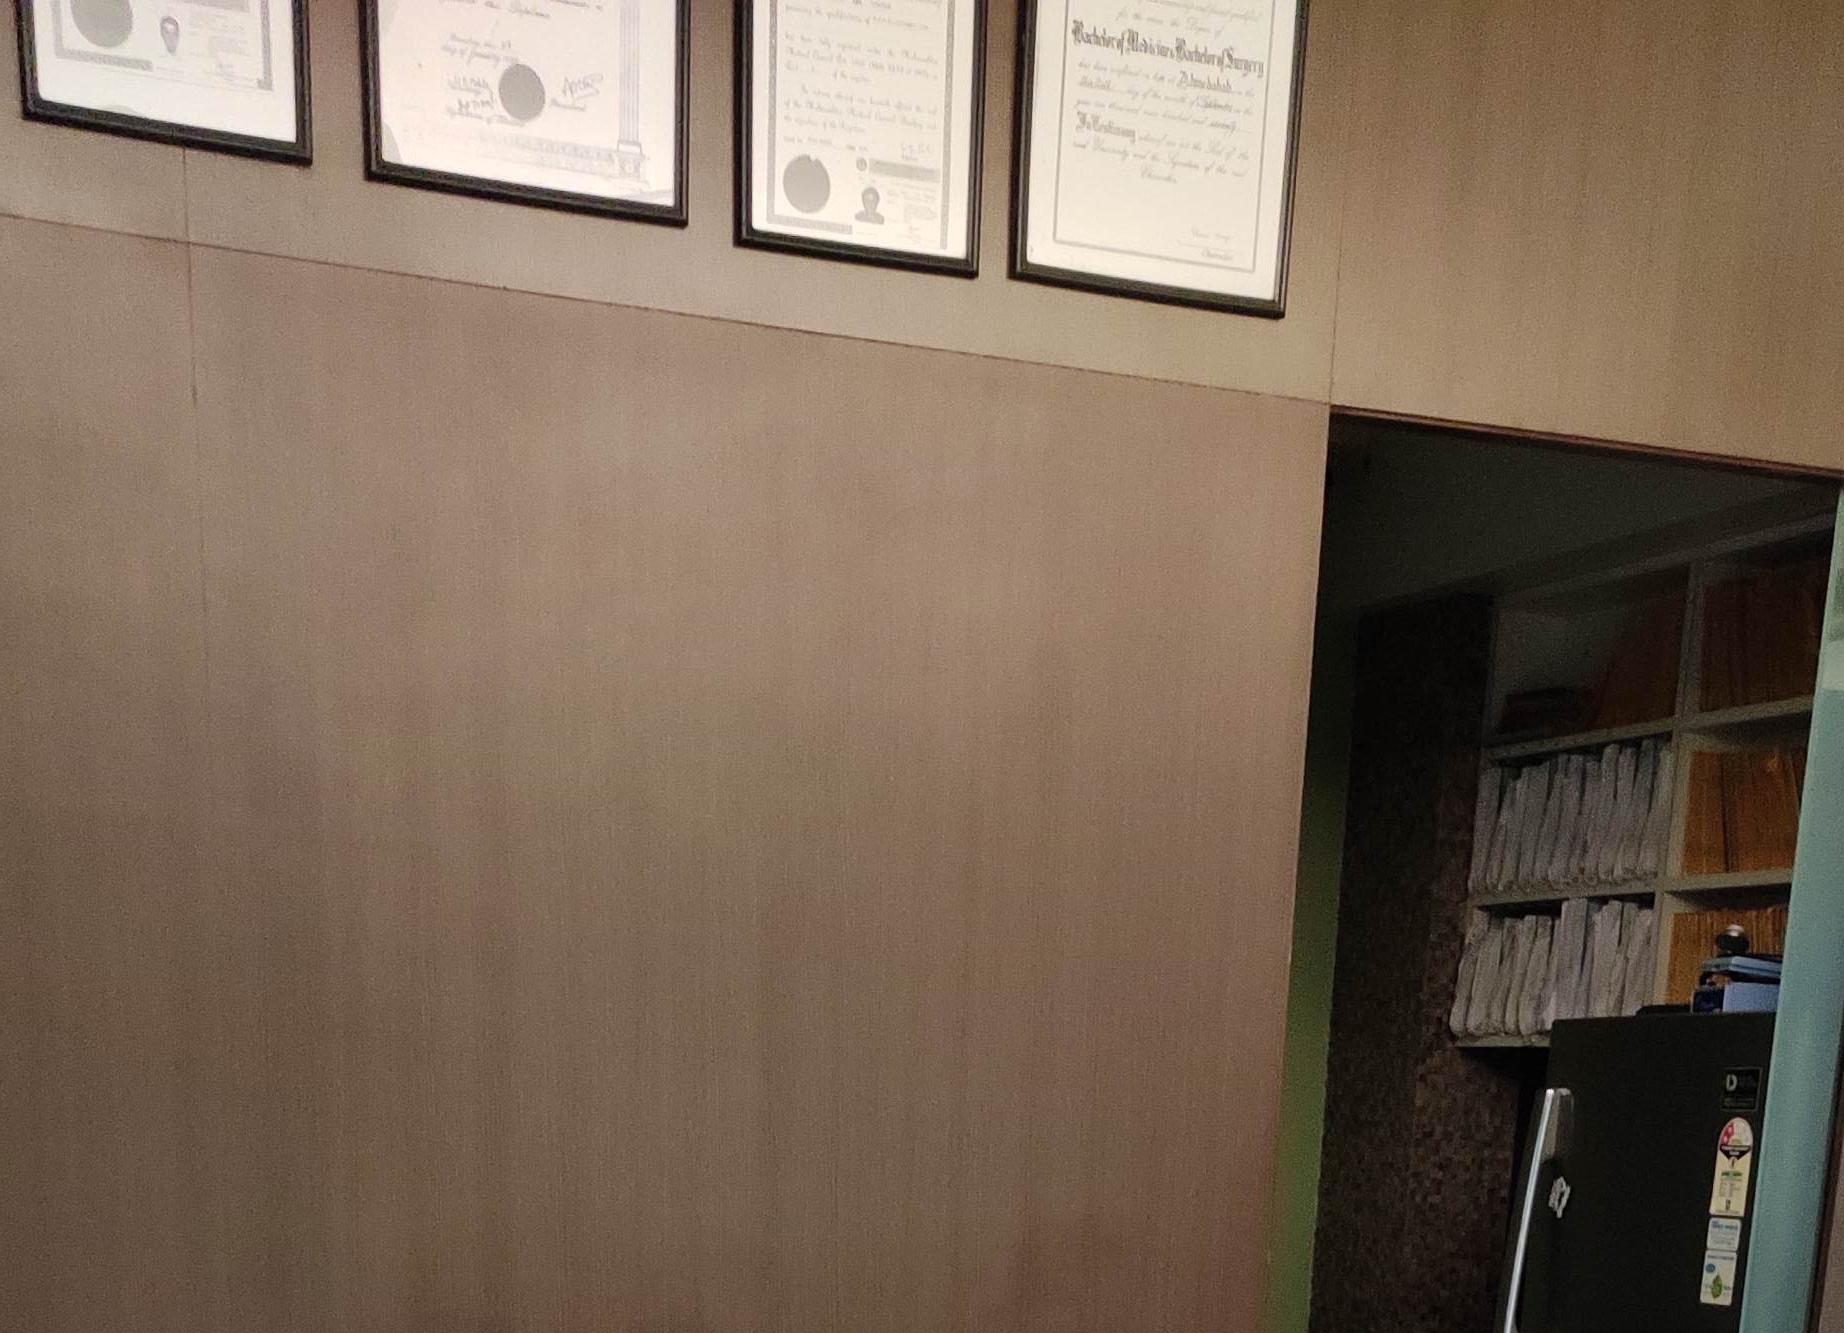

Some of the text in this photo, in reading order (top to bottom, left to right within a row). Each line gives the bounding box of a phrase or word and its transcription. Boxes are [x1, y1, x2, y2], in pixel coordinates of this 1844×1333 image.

[1072, 20, 1116, 49] Bachelor
[1116, 31, 1126, 56] of
[1126, 28, 1169, 58] Medicine
[1175, 37, 1217, 66] Bachelor
[1223, 45, 1265, 79] Surgery
